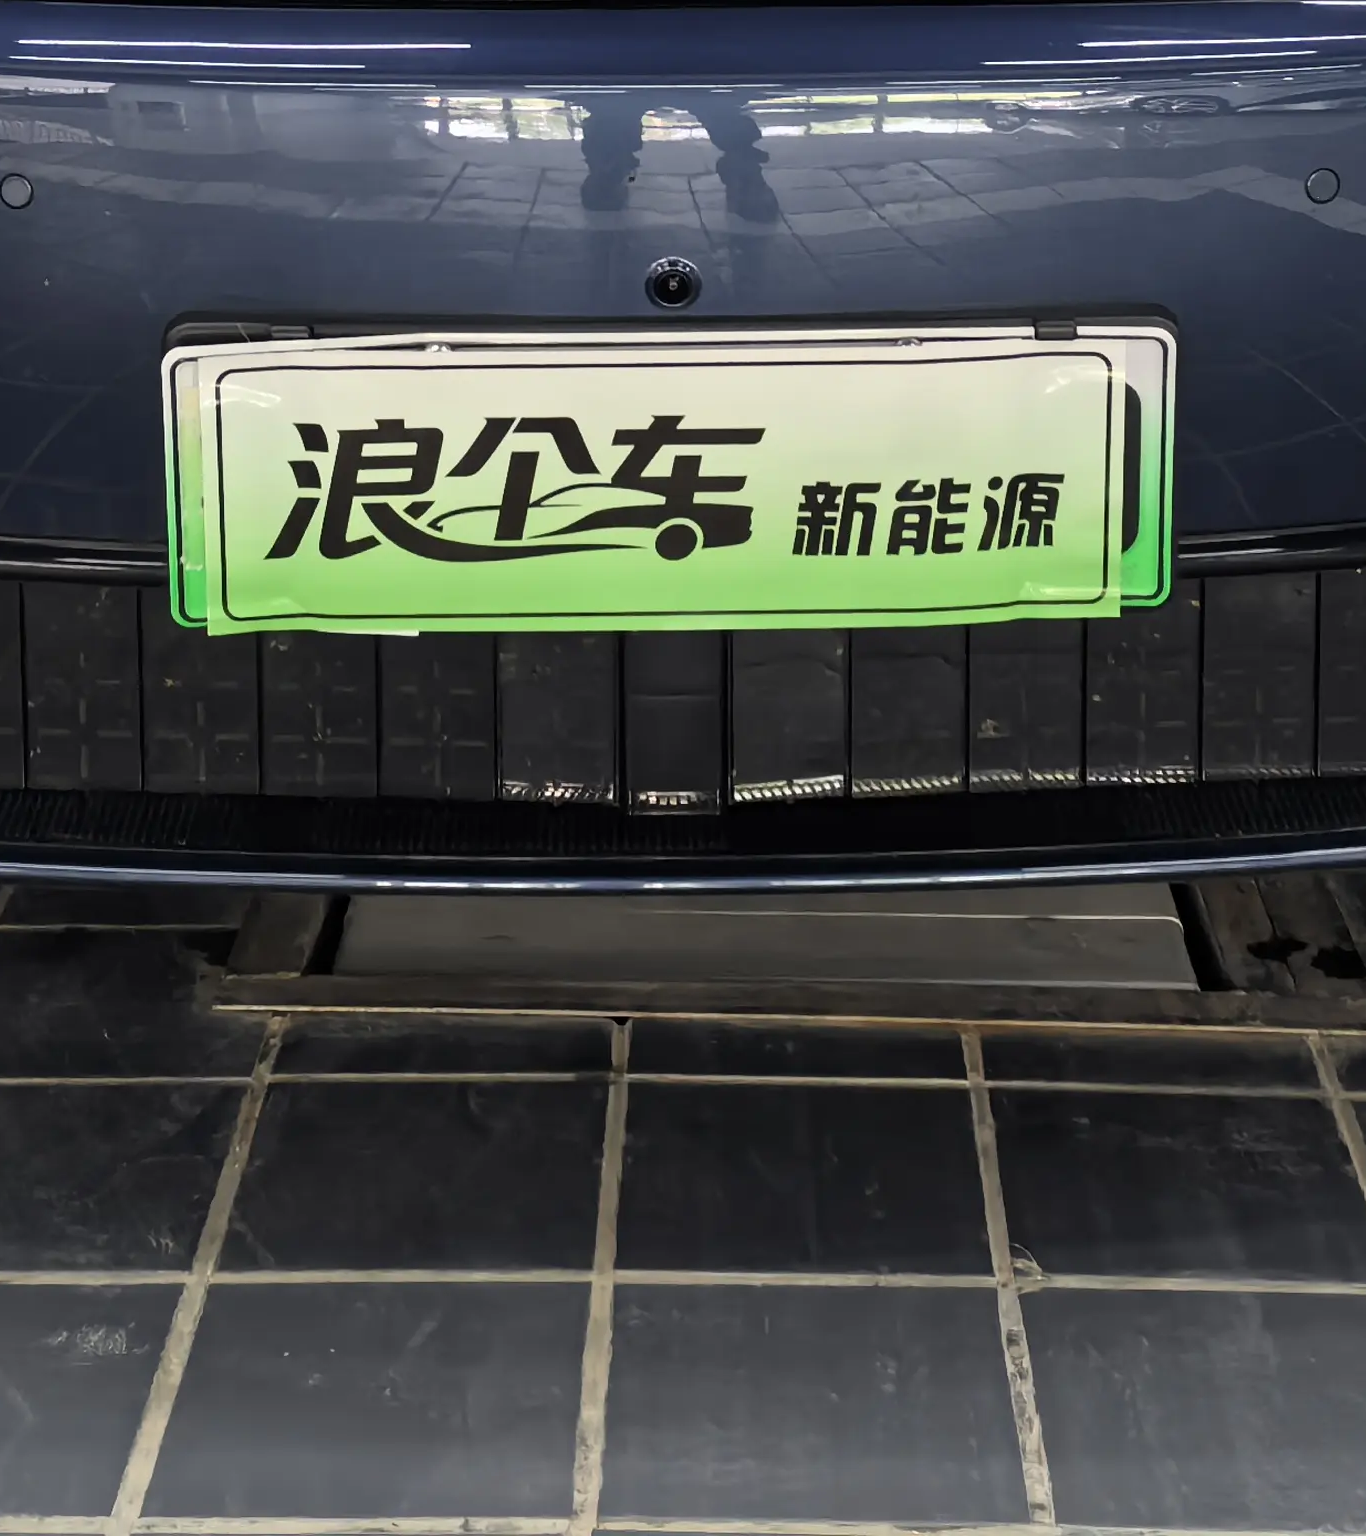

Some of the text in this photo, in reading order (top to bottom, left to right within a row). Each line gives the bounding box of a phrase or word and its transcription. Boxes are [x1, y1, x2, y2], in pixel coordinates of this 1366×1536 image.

[263, 414, 1065, 562] 浪个车 新能源
